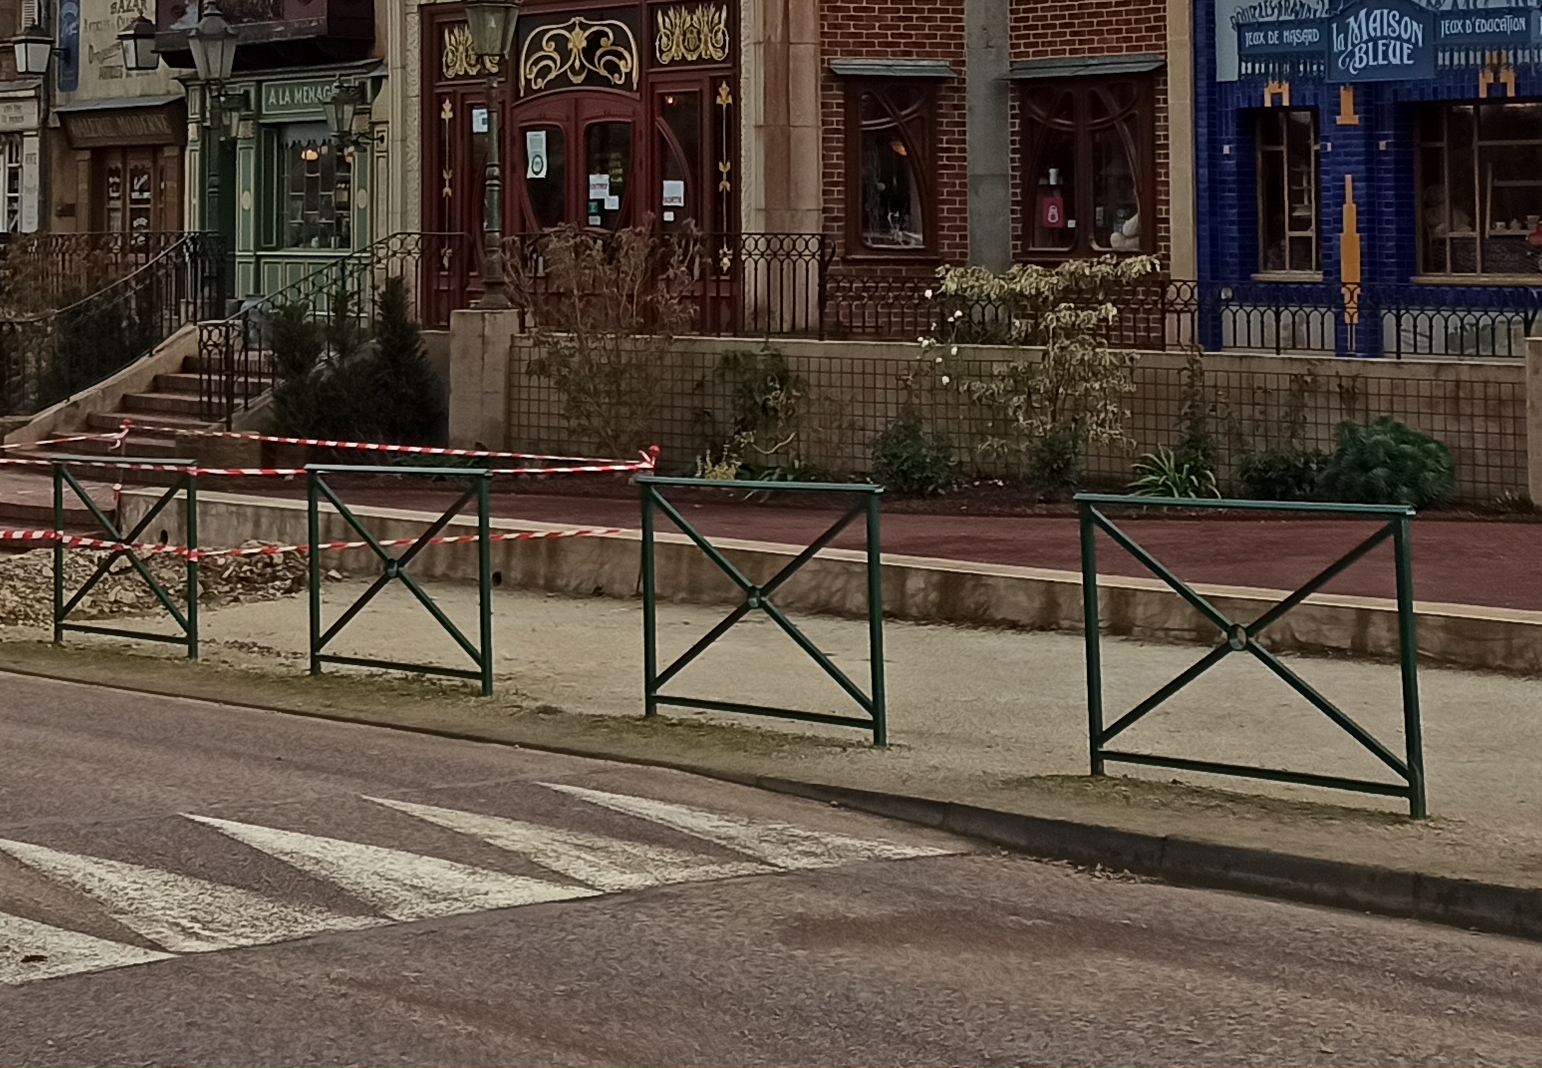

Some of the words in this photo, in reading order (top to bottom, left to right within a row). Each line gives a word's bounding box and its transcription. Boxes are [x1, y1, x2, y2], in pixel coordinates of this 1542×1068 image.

[1345, 7, 1424, 53] MAISON
[1440, 19, 1464, 38] JEUX
[1245, 30, 1266, 47] JEUX
[1267, 30, 1280, 45] DE
[1339, 39, 1415, 75] BLEUE
[268, 88, 277, 106] A
[279, 87, 292, 106] LA
